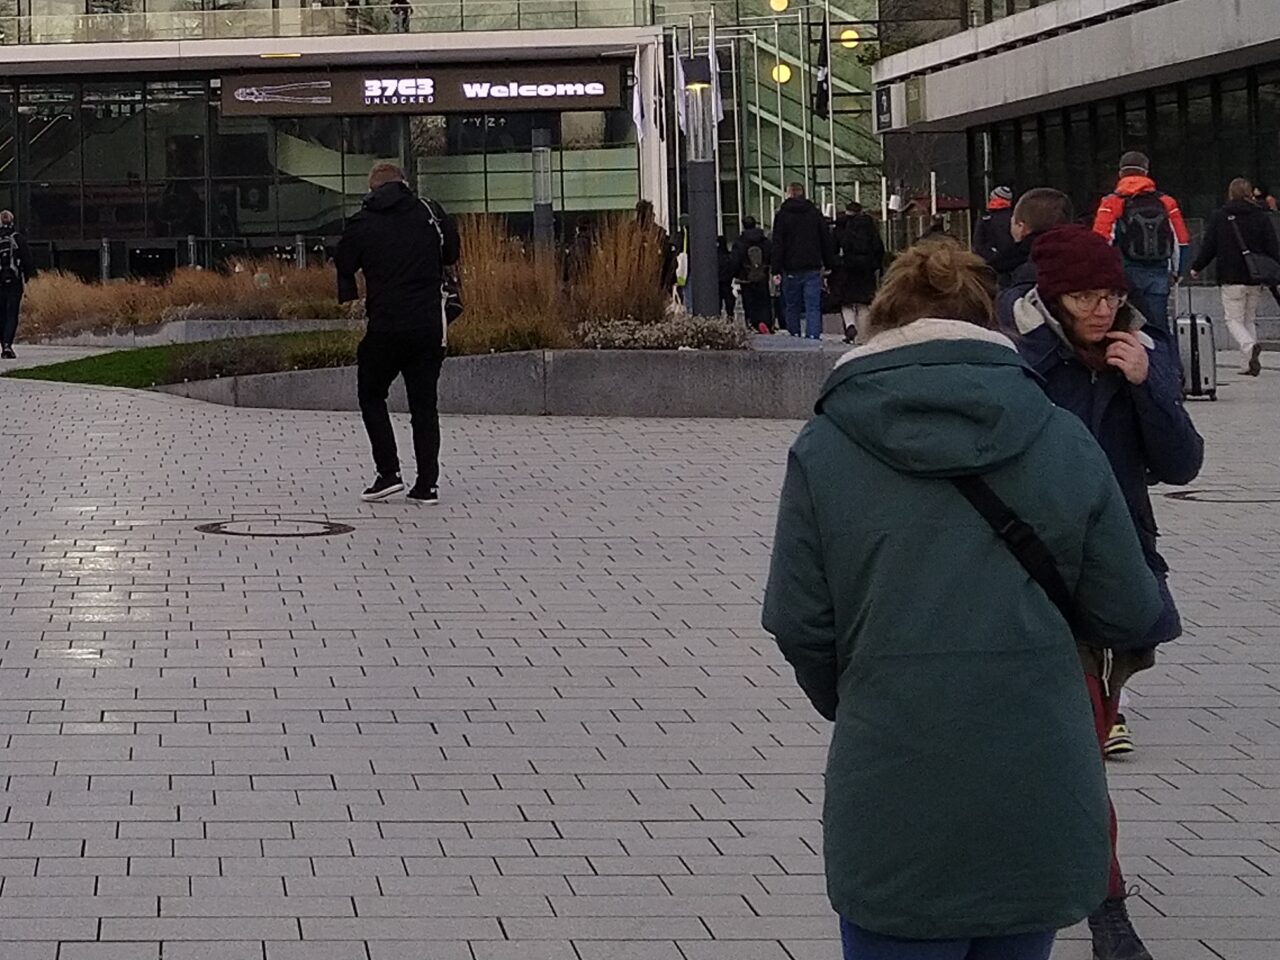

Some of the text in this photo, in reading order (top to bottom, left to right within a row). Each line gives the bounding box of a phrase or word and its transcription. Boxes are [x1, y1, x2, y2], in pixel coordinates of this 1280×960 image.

[364, 78, 434, 96] 37C3
[462, 82, 605, 98] Welcome
[365, 96, 434, 105] UNLOCKED
